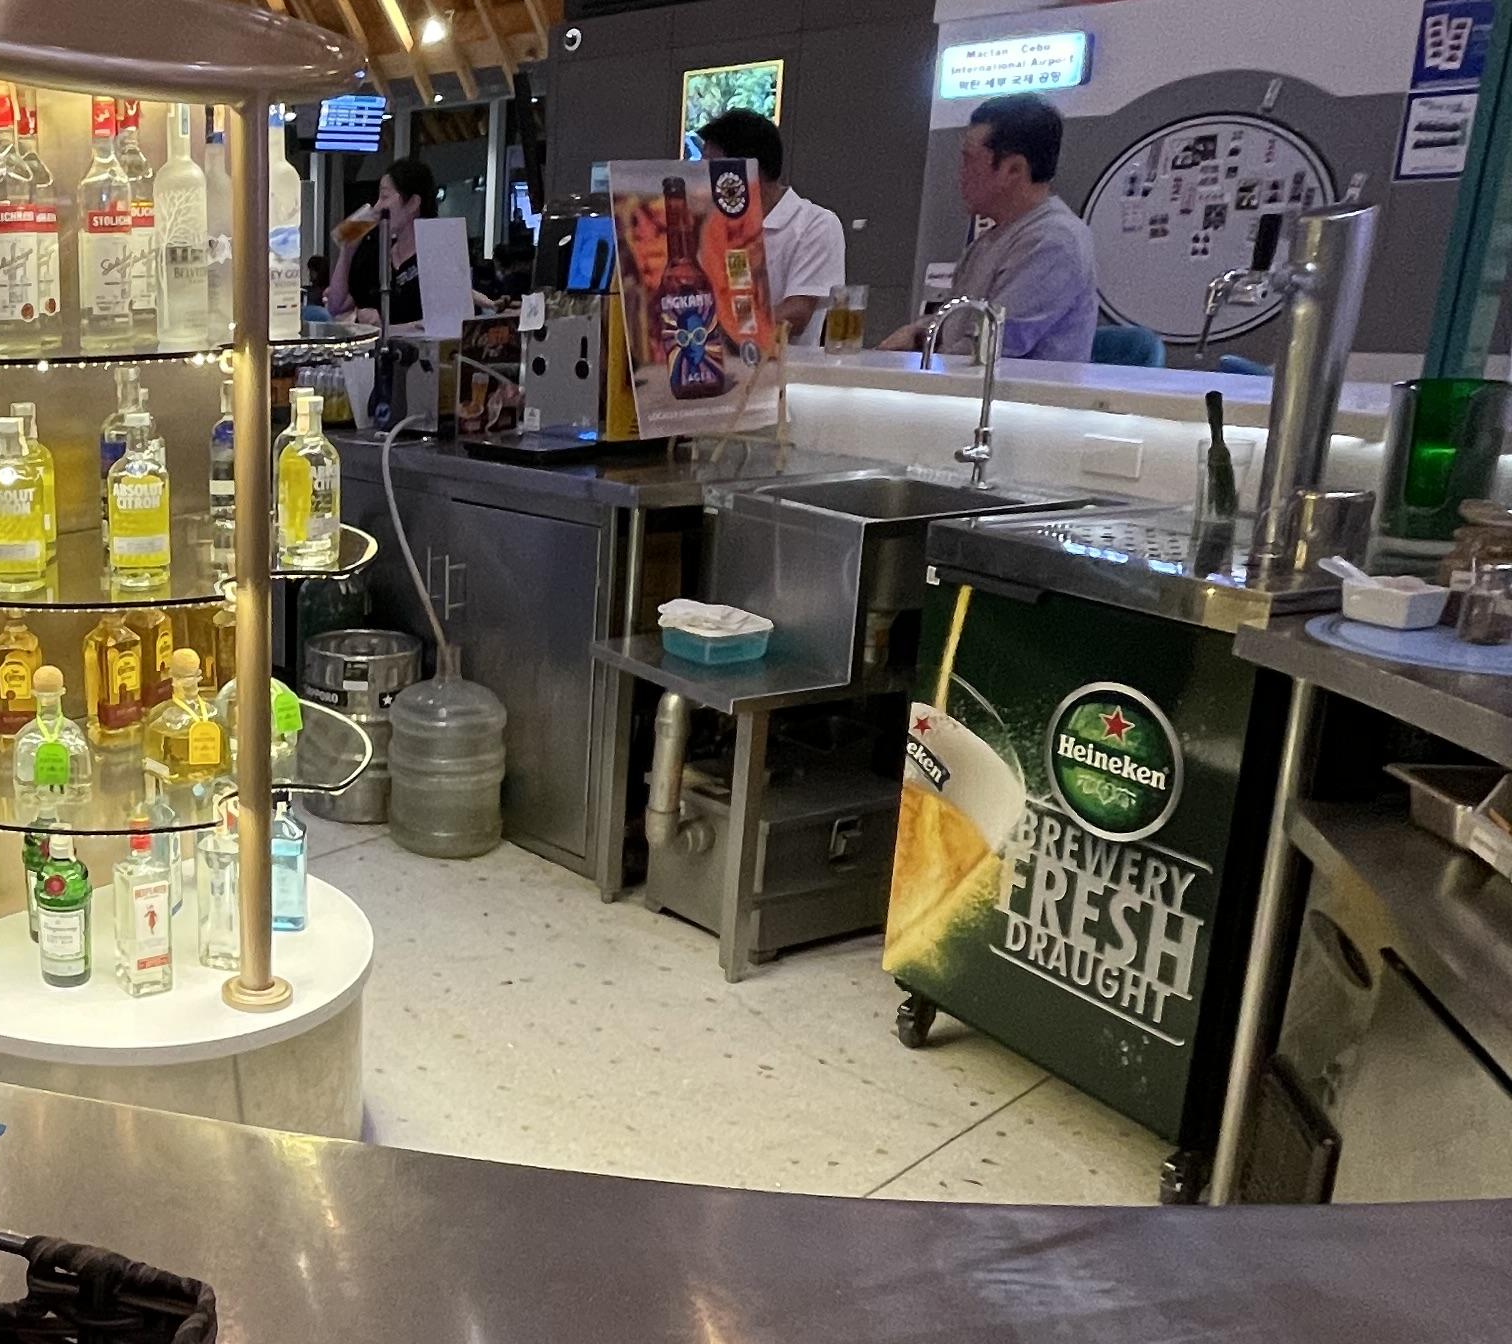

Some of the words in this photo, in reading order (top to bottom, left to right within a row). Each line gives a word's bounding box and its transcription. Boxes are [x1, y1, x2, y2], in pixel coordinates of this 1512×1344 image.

[1057, 734, 1167, 790] Heineken
[1014, 808, 1196, 912] BREWERY
[996, 844, 1204, 1001] FRESH
[1005, 916, 1172, 1024] DRAUGHT
